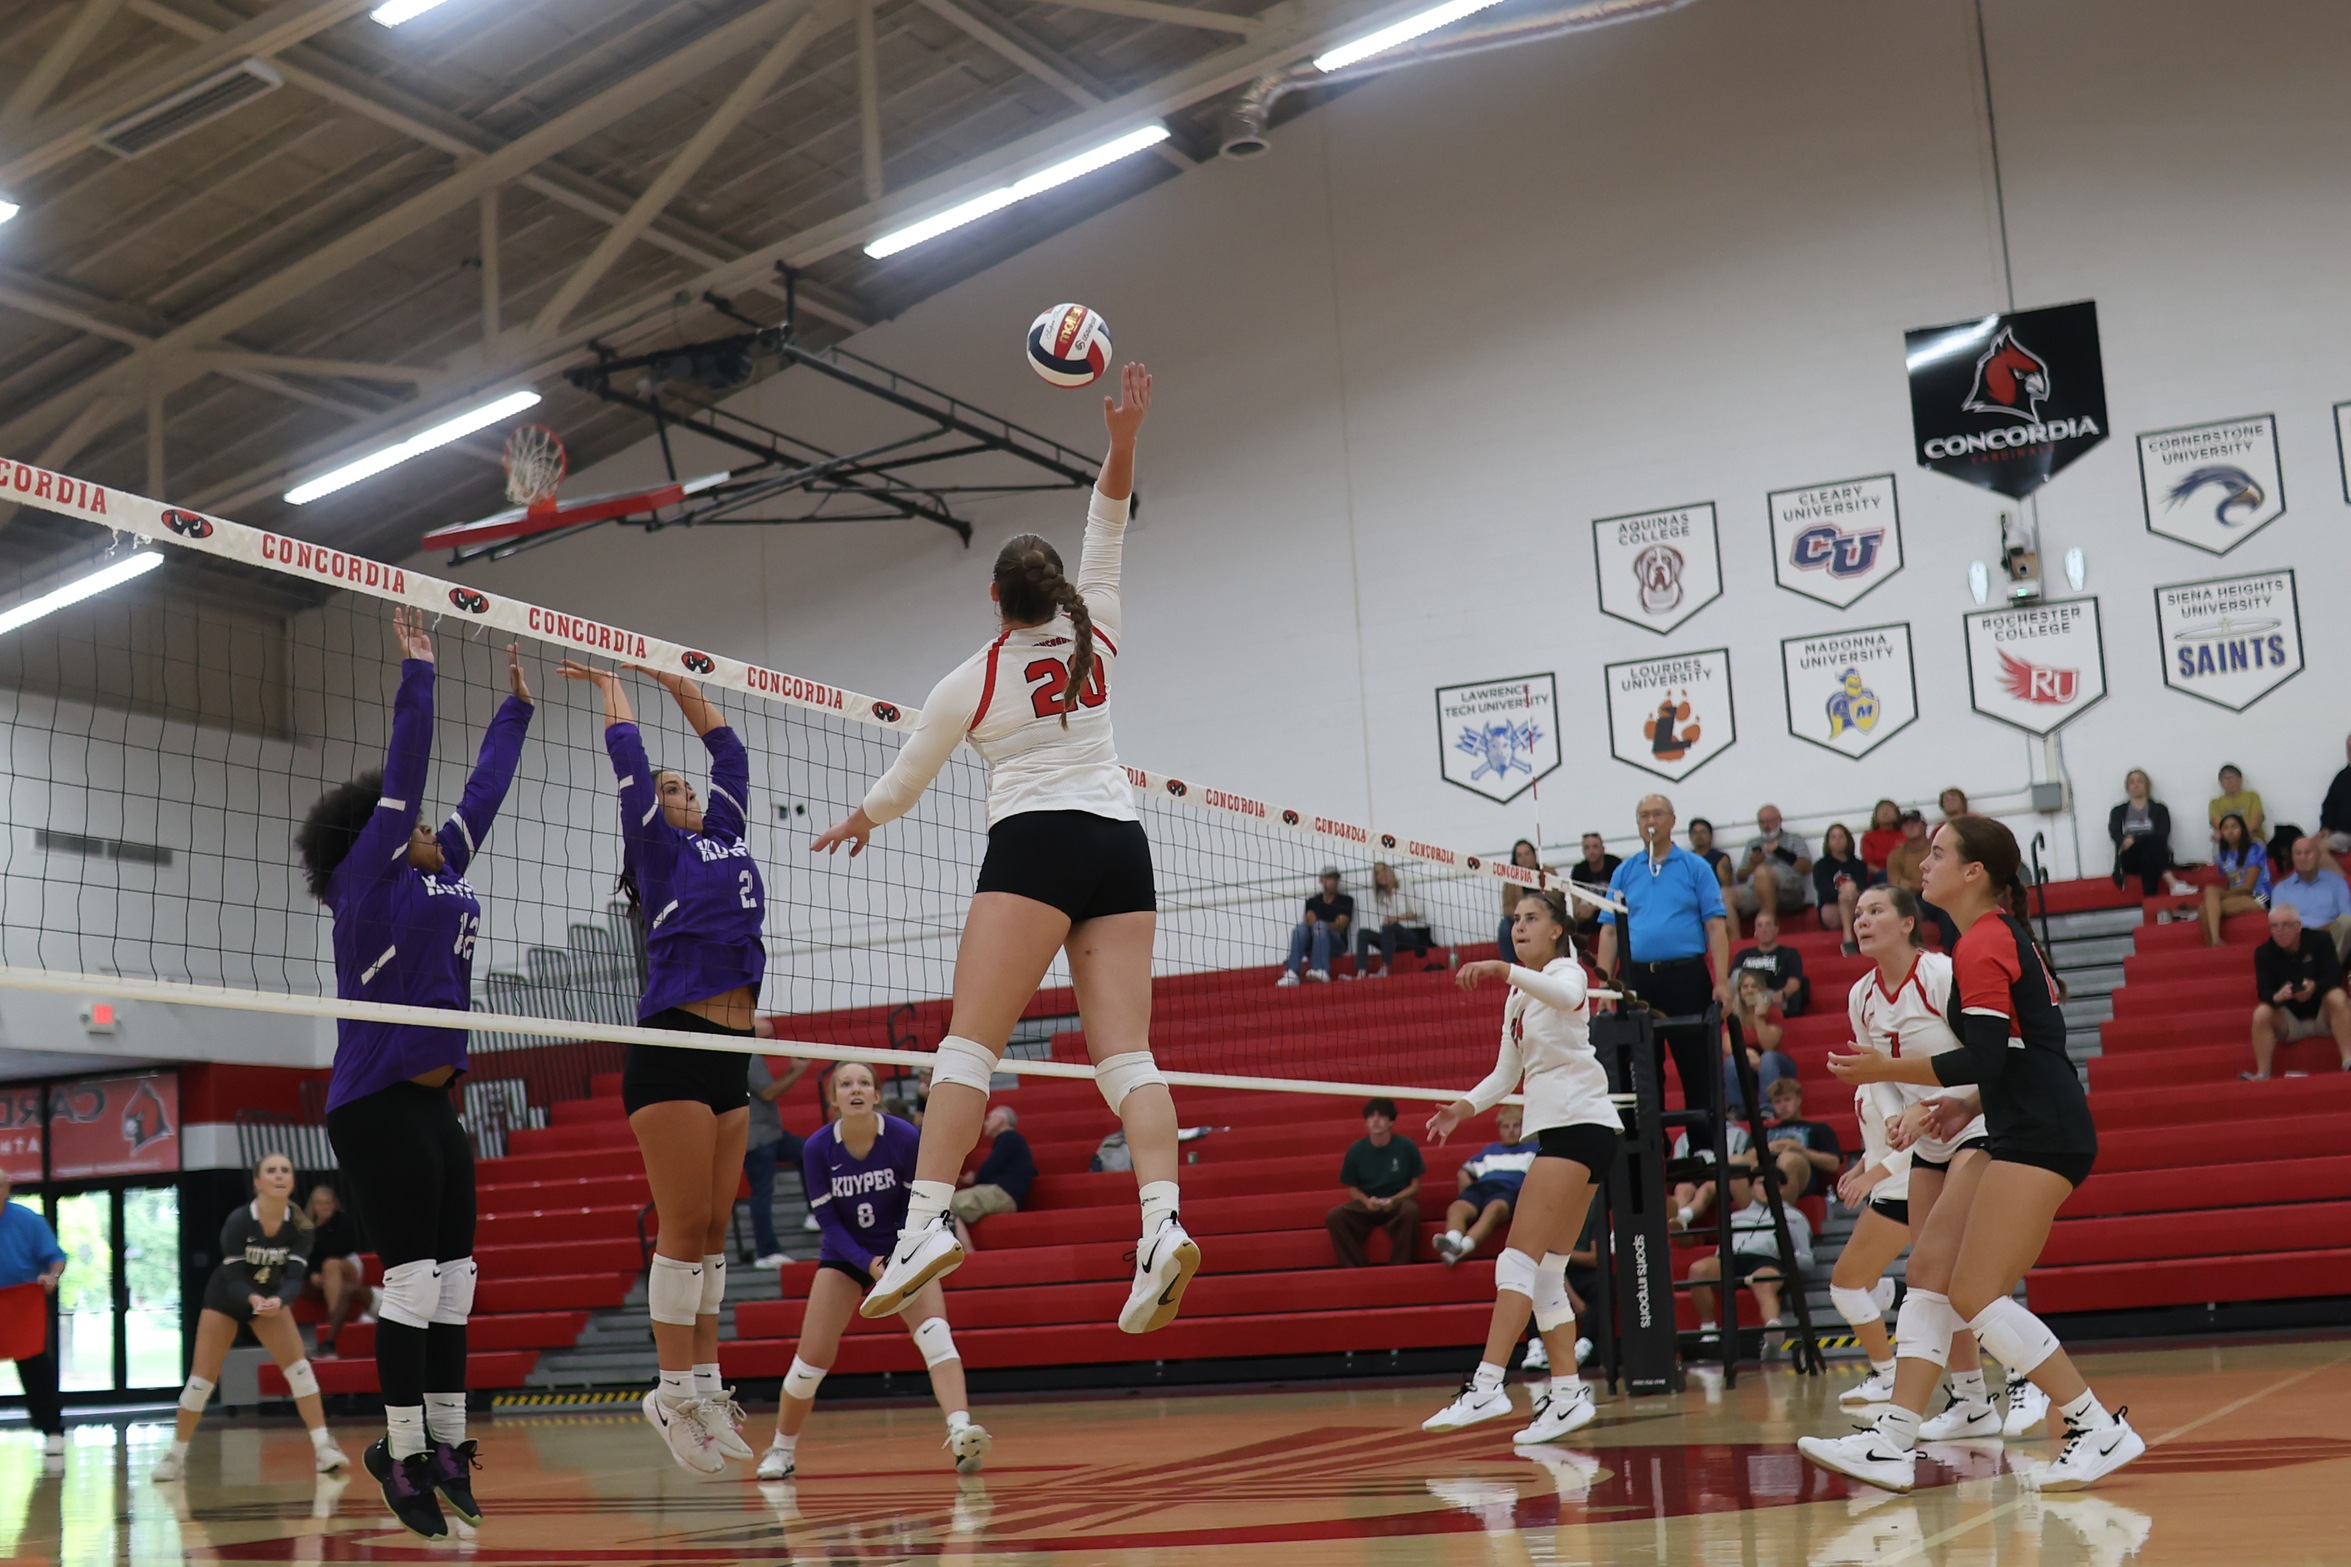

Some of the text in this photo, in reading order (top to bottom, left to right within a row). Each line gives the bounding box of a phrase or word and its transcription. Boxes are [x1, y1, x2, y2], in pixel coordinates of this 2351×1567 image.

[1923, 415, 2099, 459] CONCORDIA
[2149, 425, 2263, 452] CORNERSTONE
[2162, 440, 2252, 465] UNIVERSITY
[1798, 486, 1862, 505] CLEARY
[1782, 496, 1880, 522] UNIVERSITY
[1618, 513, 1688, 533] AQUINAS
[1618, 526, 1689, 546] COLLEGE
[262, 534, 406, 595] CONCORDIA
[1789, 523, 1885, 580] CU
[2167, 580, 2284, 606] SIENA HEIGHTS
[1982, 607, 2080, 630] ROCHESTER
[2181, 596, 2271, 618] UNIVERSITY
[529, 607, 647, 660] CONCORDIA
[1804, 633, 1886, 655] MADONNA
[1994, 622, 2070, 642] COLLEGE
[1630, 659, 1702, 679] LOURDES
[1800, 644, 1893, 670] UNIVERSITY
[2177, 634, 2285, 678] SAINTS
[747, 666, 844, 710] CONCORDIA
[1024, 652, 1107, 719] 20
[1621, 668, 1711, 692] UNIVERSITY
[2029, 667, 2079, 703] RU
[1444, 704, 1475, 718] TECH
[1206, 788, 1265, 818] CONCORDIA
[1315, 816, 1367, 843] CONCORDIA
[1409, 840, 1455, 865] CONCORDIA
[1493, 861, 1533, 883] CONCORDIA
[738, 869, 757, 909] 2
[454, 912, 480, 960] 12
[831, 1167, 897, 1198] KUYPER
[856, 1202, 876, 1229] 8
[1632, 1233, 1648, 1276] sports
[253, 1266, 271, 1285] 4
